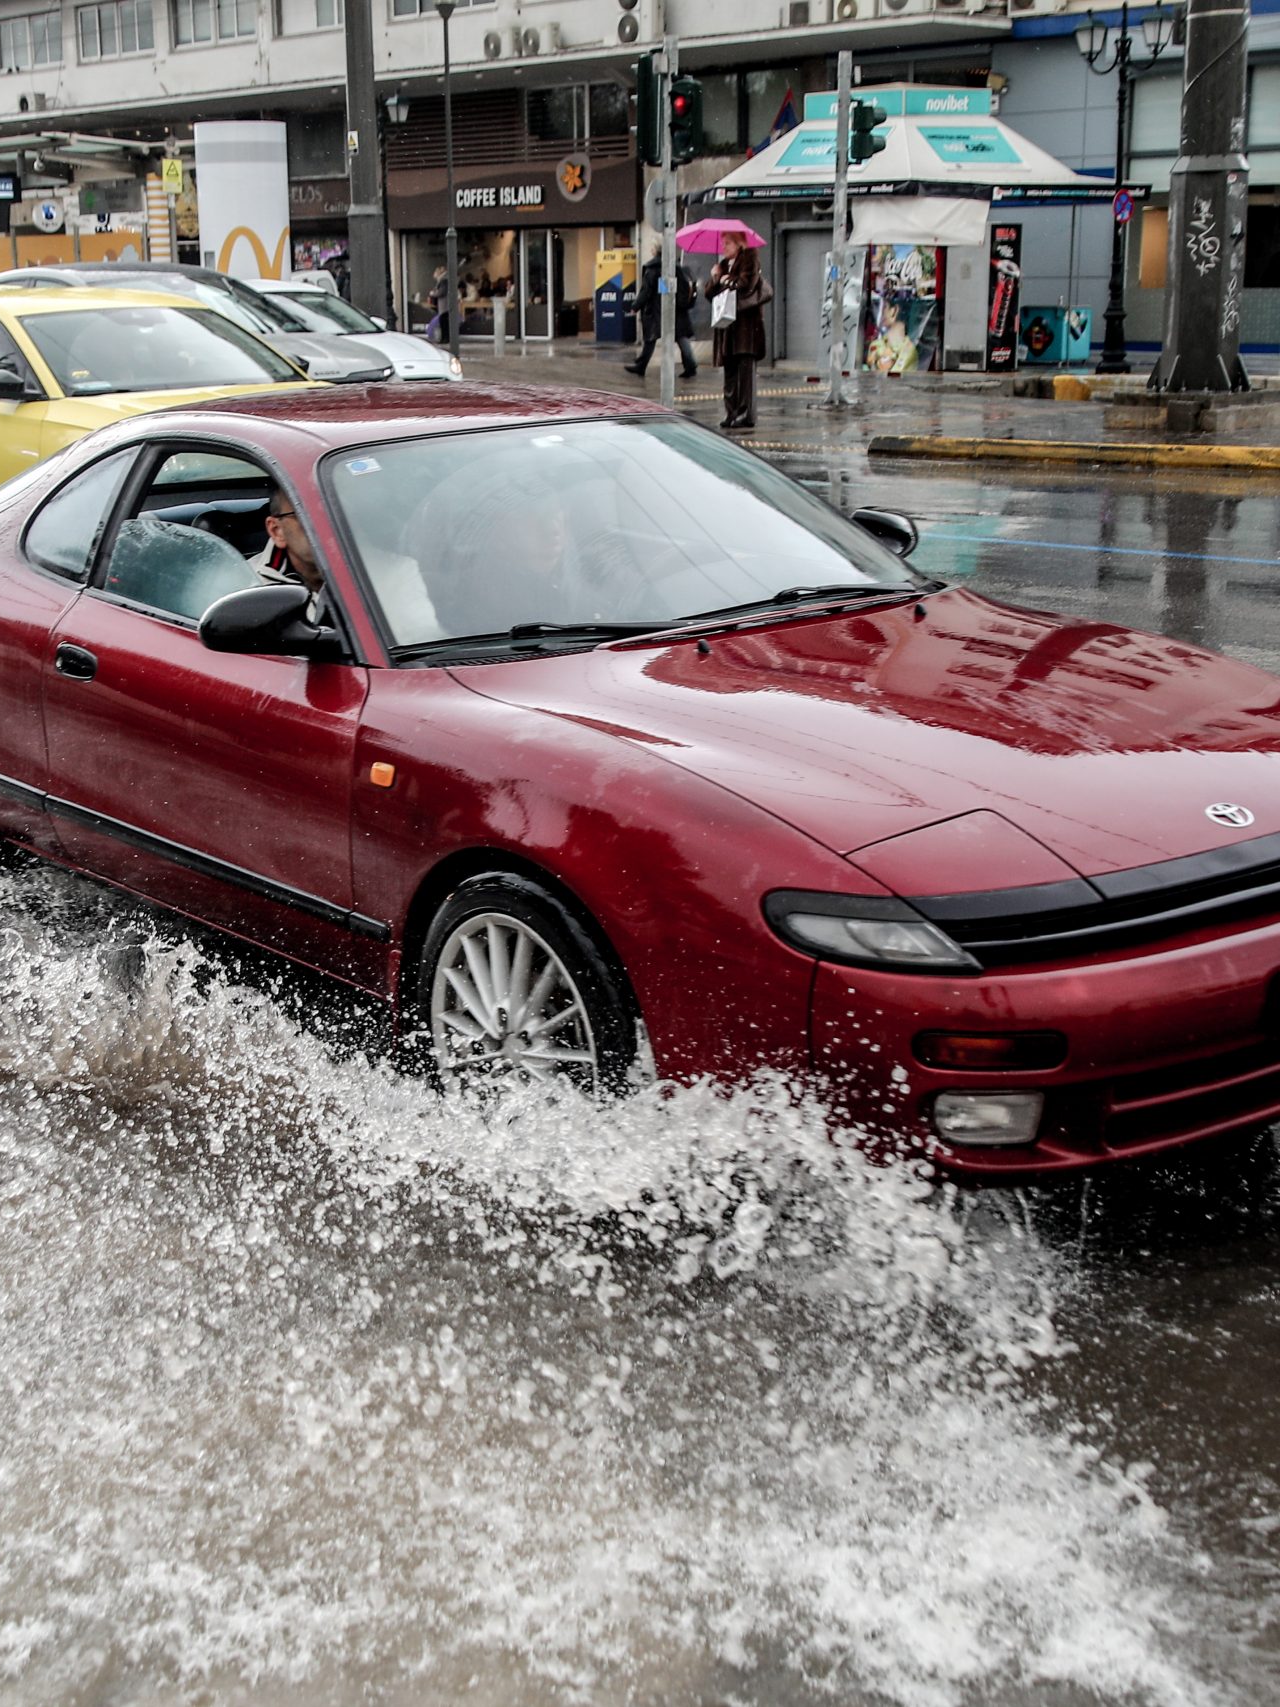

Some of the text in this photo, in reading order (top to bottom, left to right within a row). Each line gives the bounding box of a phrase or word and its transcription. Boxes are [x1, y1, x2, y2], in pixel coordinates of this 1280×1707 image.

[925, 94, 970, 114] novibet
[456, 185, 542, 208] COFFEE ISLAND
[601, 292, 617, 302] ATM
